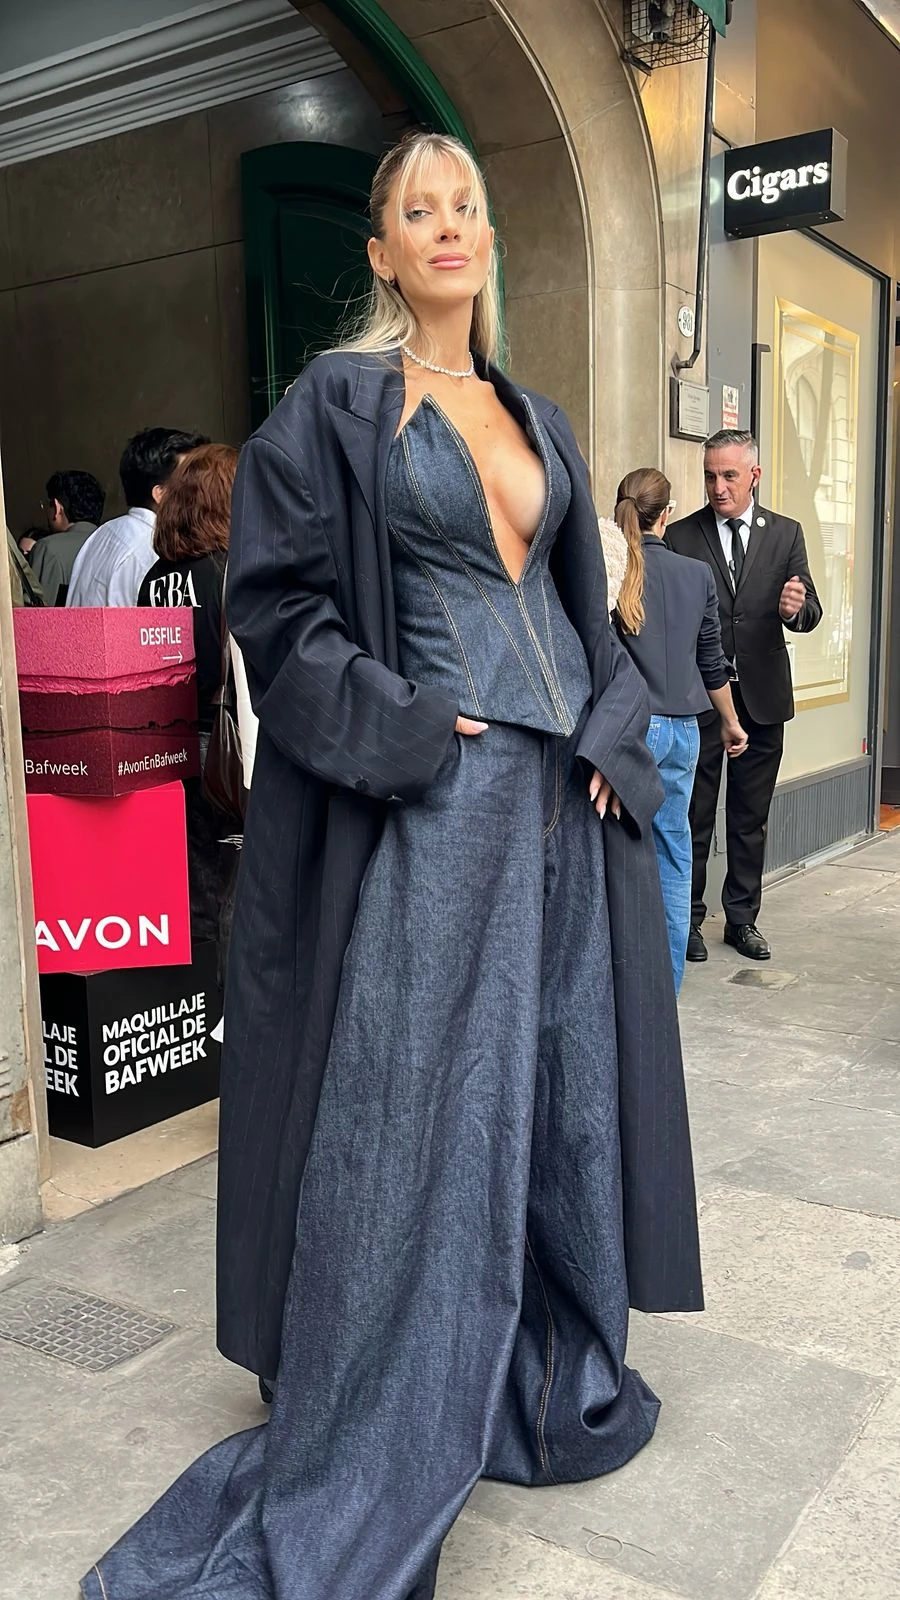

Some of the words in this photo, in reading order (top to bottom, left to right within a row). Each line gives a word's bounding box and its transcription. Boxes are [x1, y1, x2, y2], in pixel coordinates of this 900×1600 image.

[727, 162, 829, 203] Cigars
[149, 570, 202, 607] EBA
[140, 627, 182, 646] DESFILE
[118, 748, 188, 776] #AvonEnBafweek
[35, 914, 169, 951] AVON
[102, 992, 206, 1042] MAQUILLAJE
[54, 1045, 78, 1070] DE
[103, 1027, 179, 1066] OFICIAL
[183, 1013, 206, 1038] DE
[104, 1036, 207, 1094] BAFWEEK
